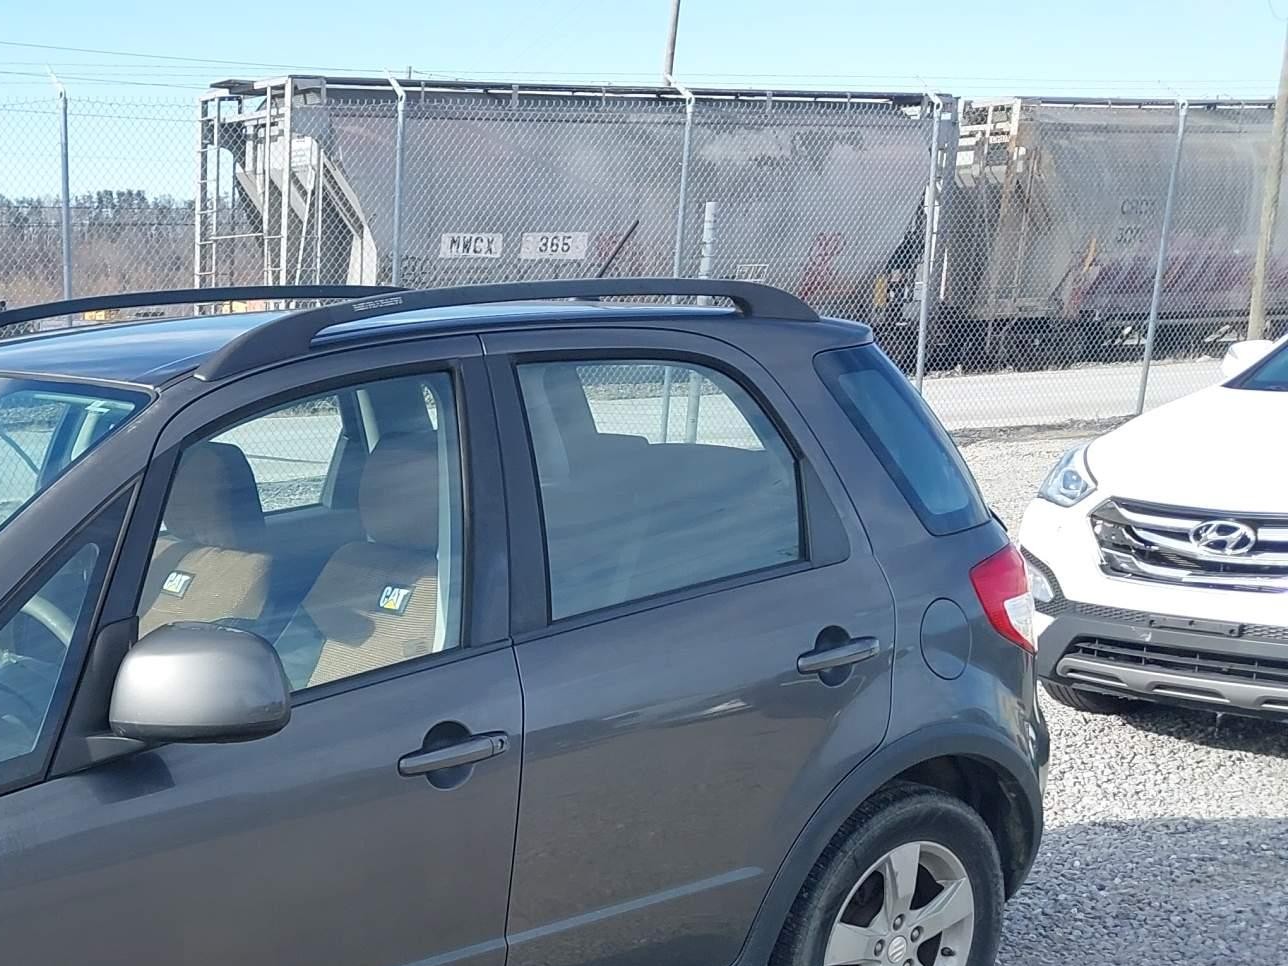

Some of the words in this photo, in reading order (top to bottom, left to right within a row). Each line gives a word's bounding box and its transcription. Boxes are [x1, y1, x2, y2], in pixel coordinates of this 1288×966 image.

[449, 236, 495, 255] MWCX
[538, 235, 573, 254] 365
[162, 571, 192, 593] CAT
[379, 586, 410, 610] CAT
